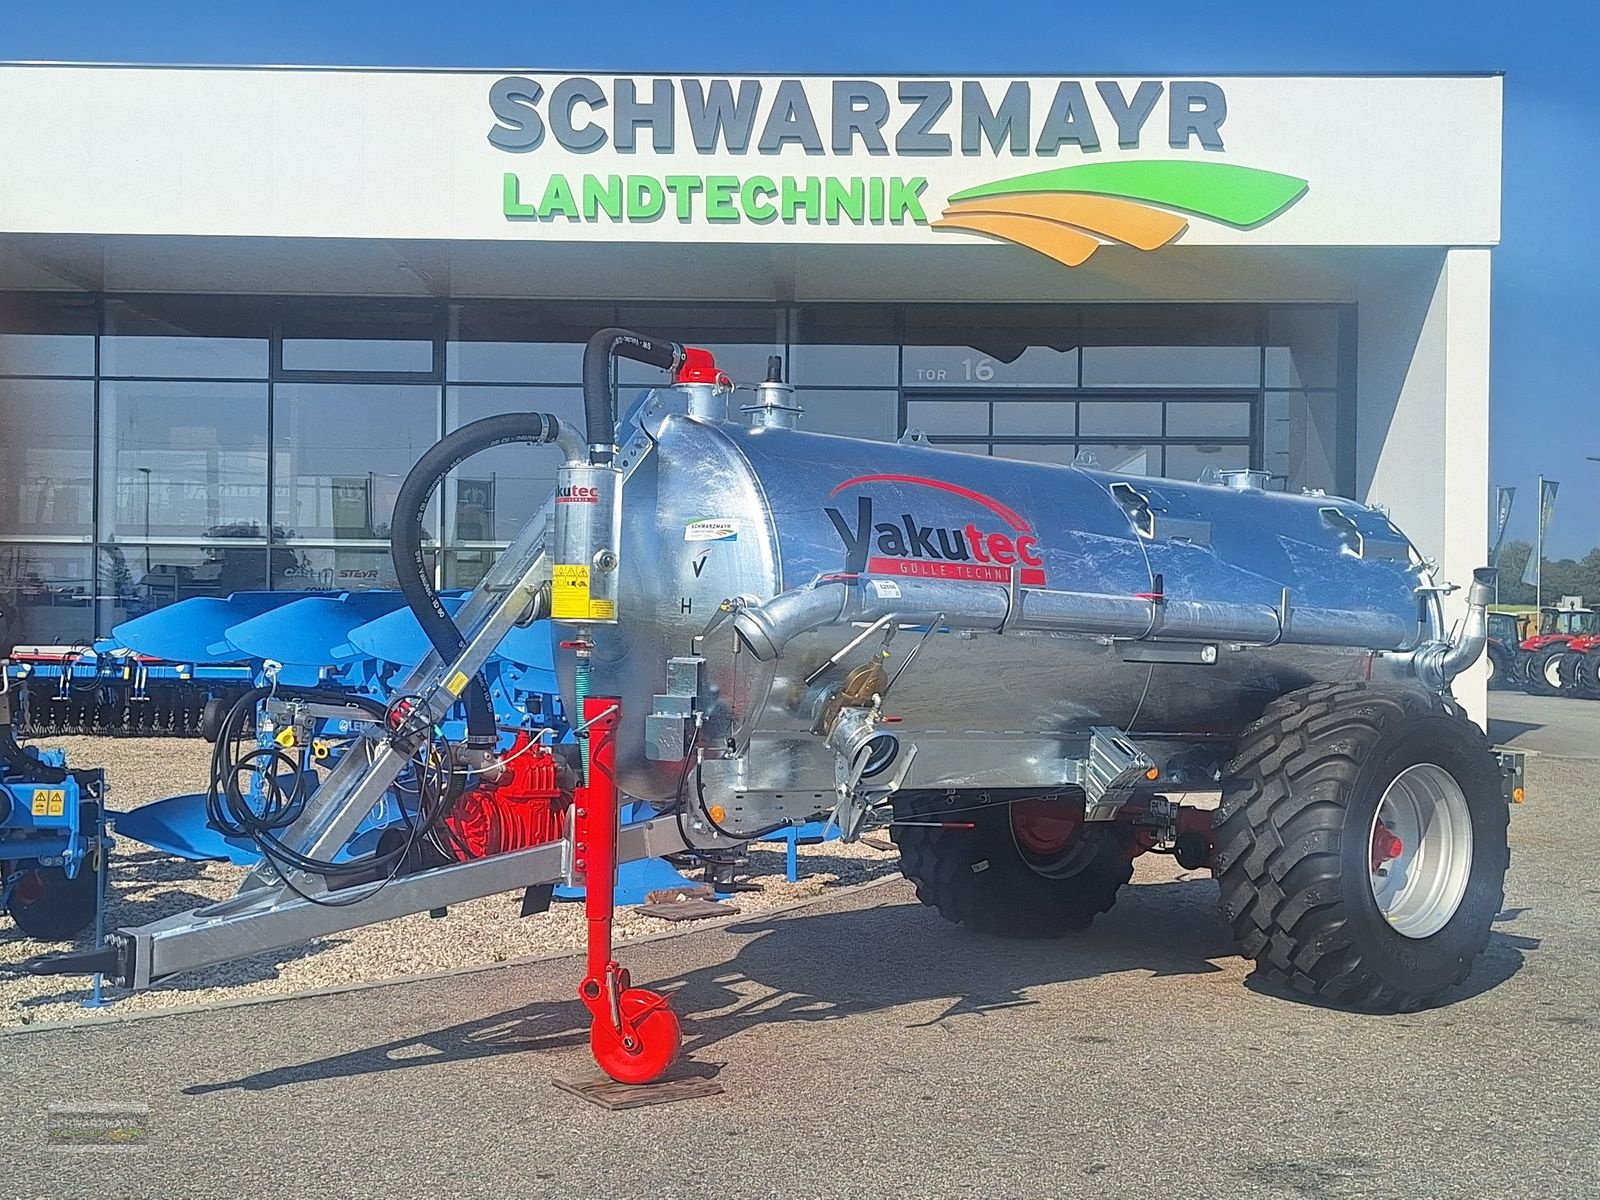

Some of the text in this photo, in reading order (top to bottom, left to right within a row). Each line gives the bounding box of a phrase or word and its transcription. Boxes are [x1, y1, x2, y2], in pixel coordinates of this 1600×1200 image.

[487, 76, 1227, 157] SCHWARZMAYR
[503, 172, 928, 224] LANDTECHNIK
[916, 359, 994, 381] TOR 16
[556, 485, 598, 497] kutec
[339, 569, 379, 579] STEYR
[900, 562, 1012, 581] GÜLLE-TECHNI
[681, 597, 692, 614] H
[691, 639, 701, 656] L
